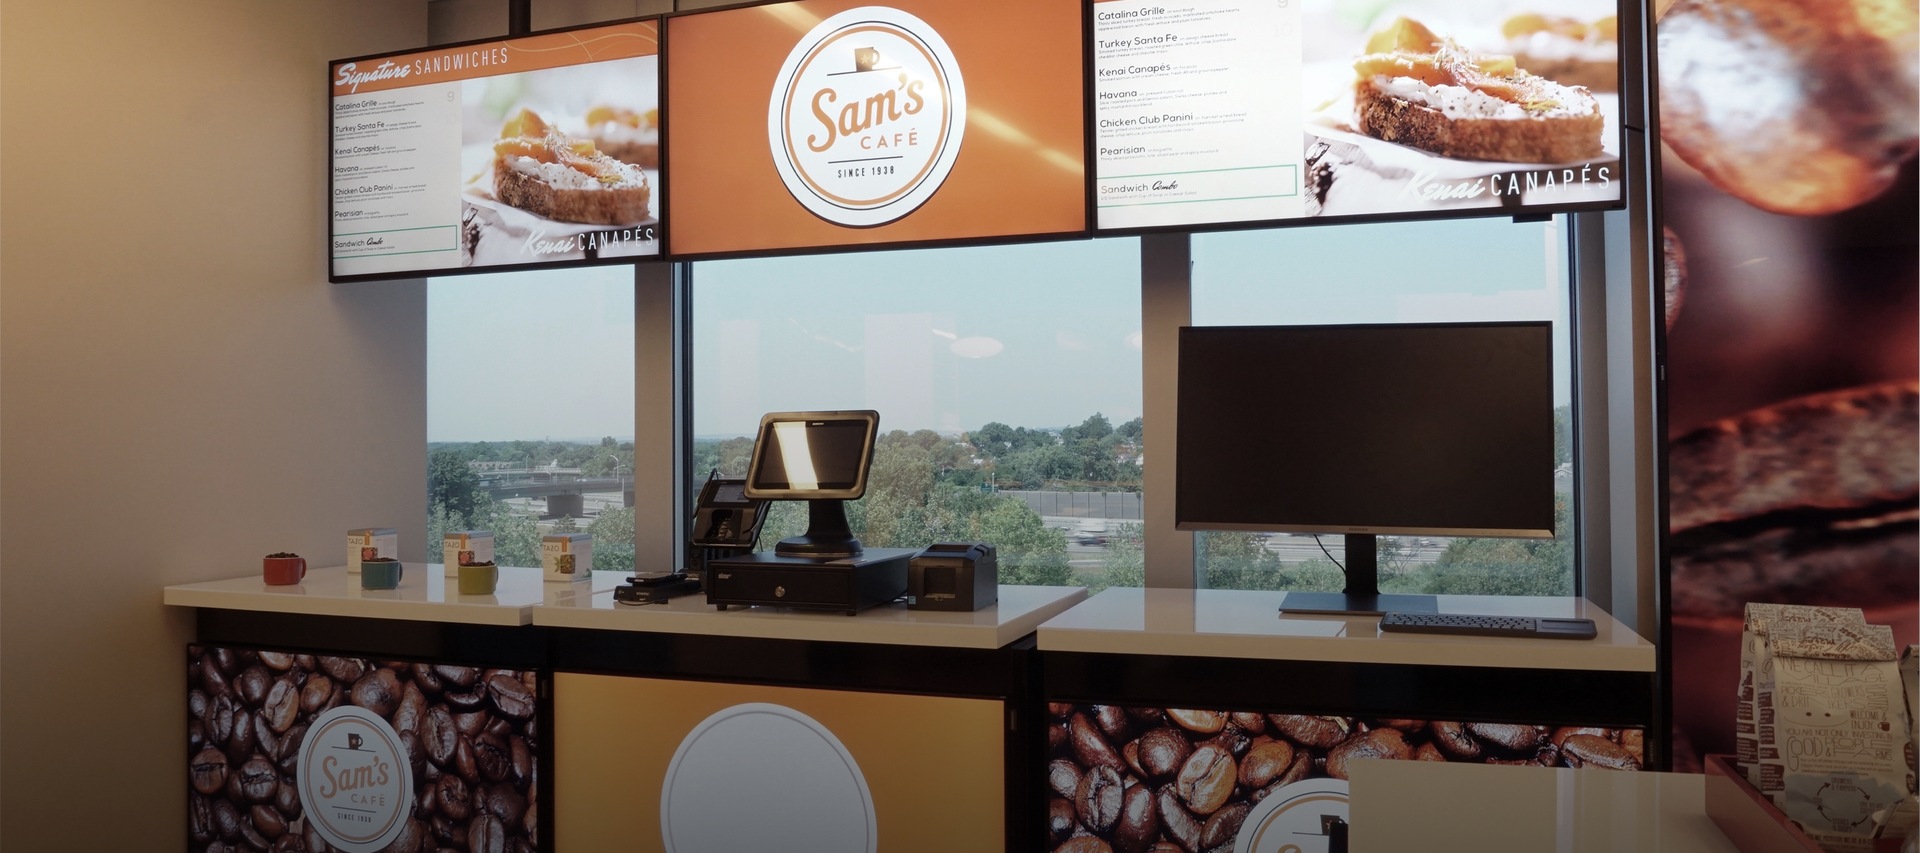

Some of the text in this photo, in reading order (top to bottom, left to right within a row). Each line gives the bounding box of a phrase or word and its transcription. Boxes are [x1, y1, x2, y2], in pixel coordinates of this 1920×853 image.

[1098, 9, 1138, 21] Catalina
[1140, 7, 1165, 17] Grille
[1099, 38, 1132, 49] Turkey
[1134, 36, 1163, 46] Santa
[1165, 34, 1178, 42] Fe
[335, 48, 508, 93] Signature SANDWICHES
[1099, 66, 1126, 77] Kenai
[1128, 63, 1171, 75] Canapés
[1099, 90, 1138, 100] Havana
[335, 101, 360, 111] Catalina
[807, 73, 924, 153] Sam's
[1100, 118, 1136, 128] Chicken
[1139, 115, 1160, 124] Club
[1162, 112, 1194, 123] Panini
[335, 124, 356, 133] Turkey
[357, 122, 375, 131] Santa
[860, 127, 918, 150] CAFÉ
[335, 147, 352, 155] Kenai
[353, 144, 380, 153] Canapés
[1100, 146, 1146, 156] Pearisian
[838, 165, 894, 179] SINCE 1938
[1101, 180, 1179, 194] Sandwich Combo
[1402, 163, 1610, 202] Kenai CANAPÉS
[335, 187, 358, 196] Chicken
[359, 186, 372, 194] Club
[374, 184, 393, 192] Panini
[335, 209, 363, 217] Pearisian
[335, 239, 365, 248] Sandwich
[519, 225, 653, 257] Kenai CANAPÉS
[1849, 710, 1879, 721] WELCOME
[1851, 720, 1874, 730] ENJOY
[1785, 728, 1800, 736] YOU
[1815, 729, 1829, 737] NOT
[1830, 729, 1849, 738] ONLY
[1786, 736, 1823, 772] GOOD
[319, 755, 389, 799] Sam's
[351, 793, 385, 807] CAFÉ
